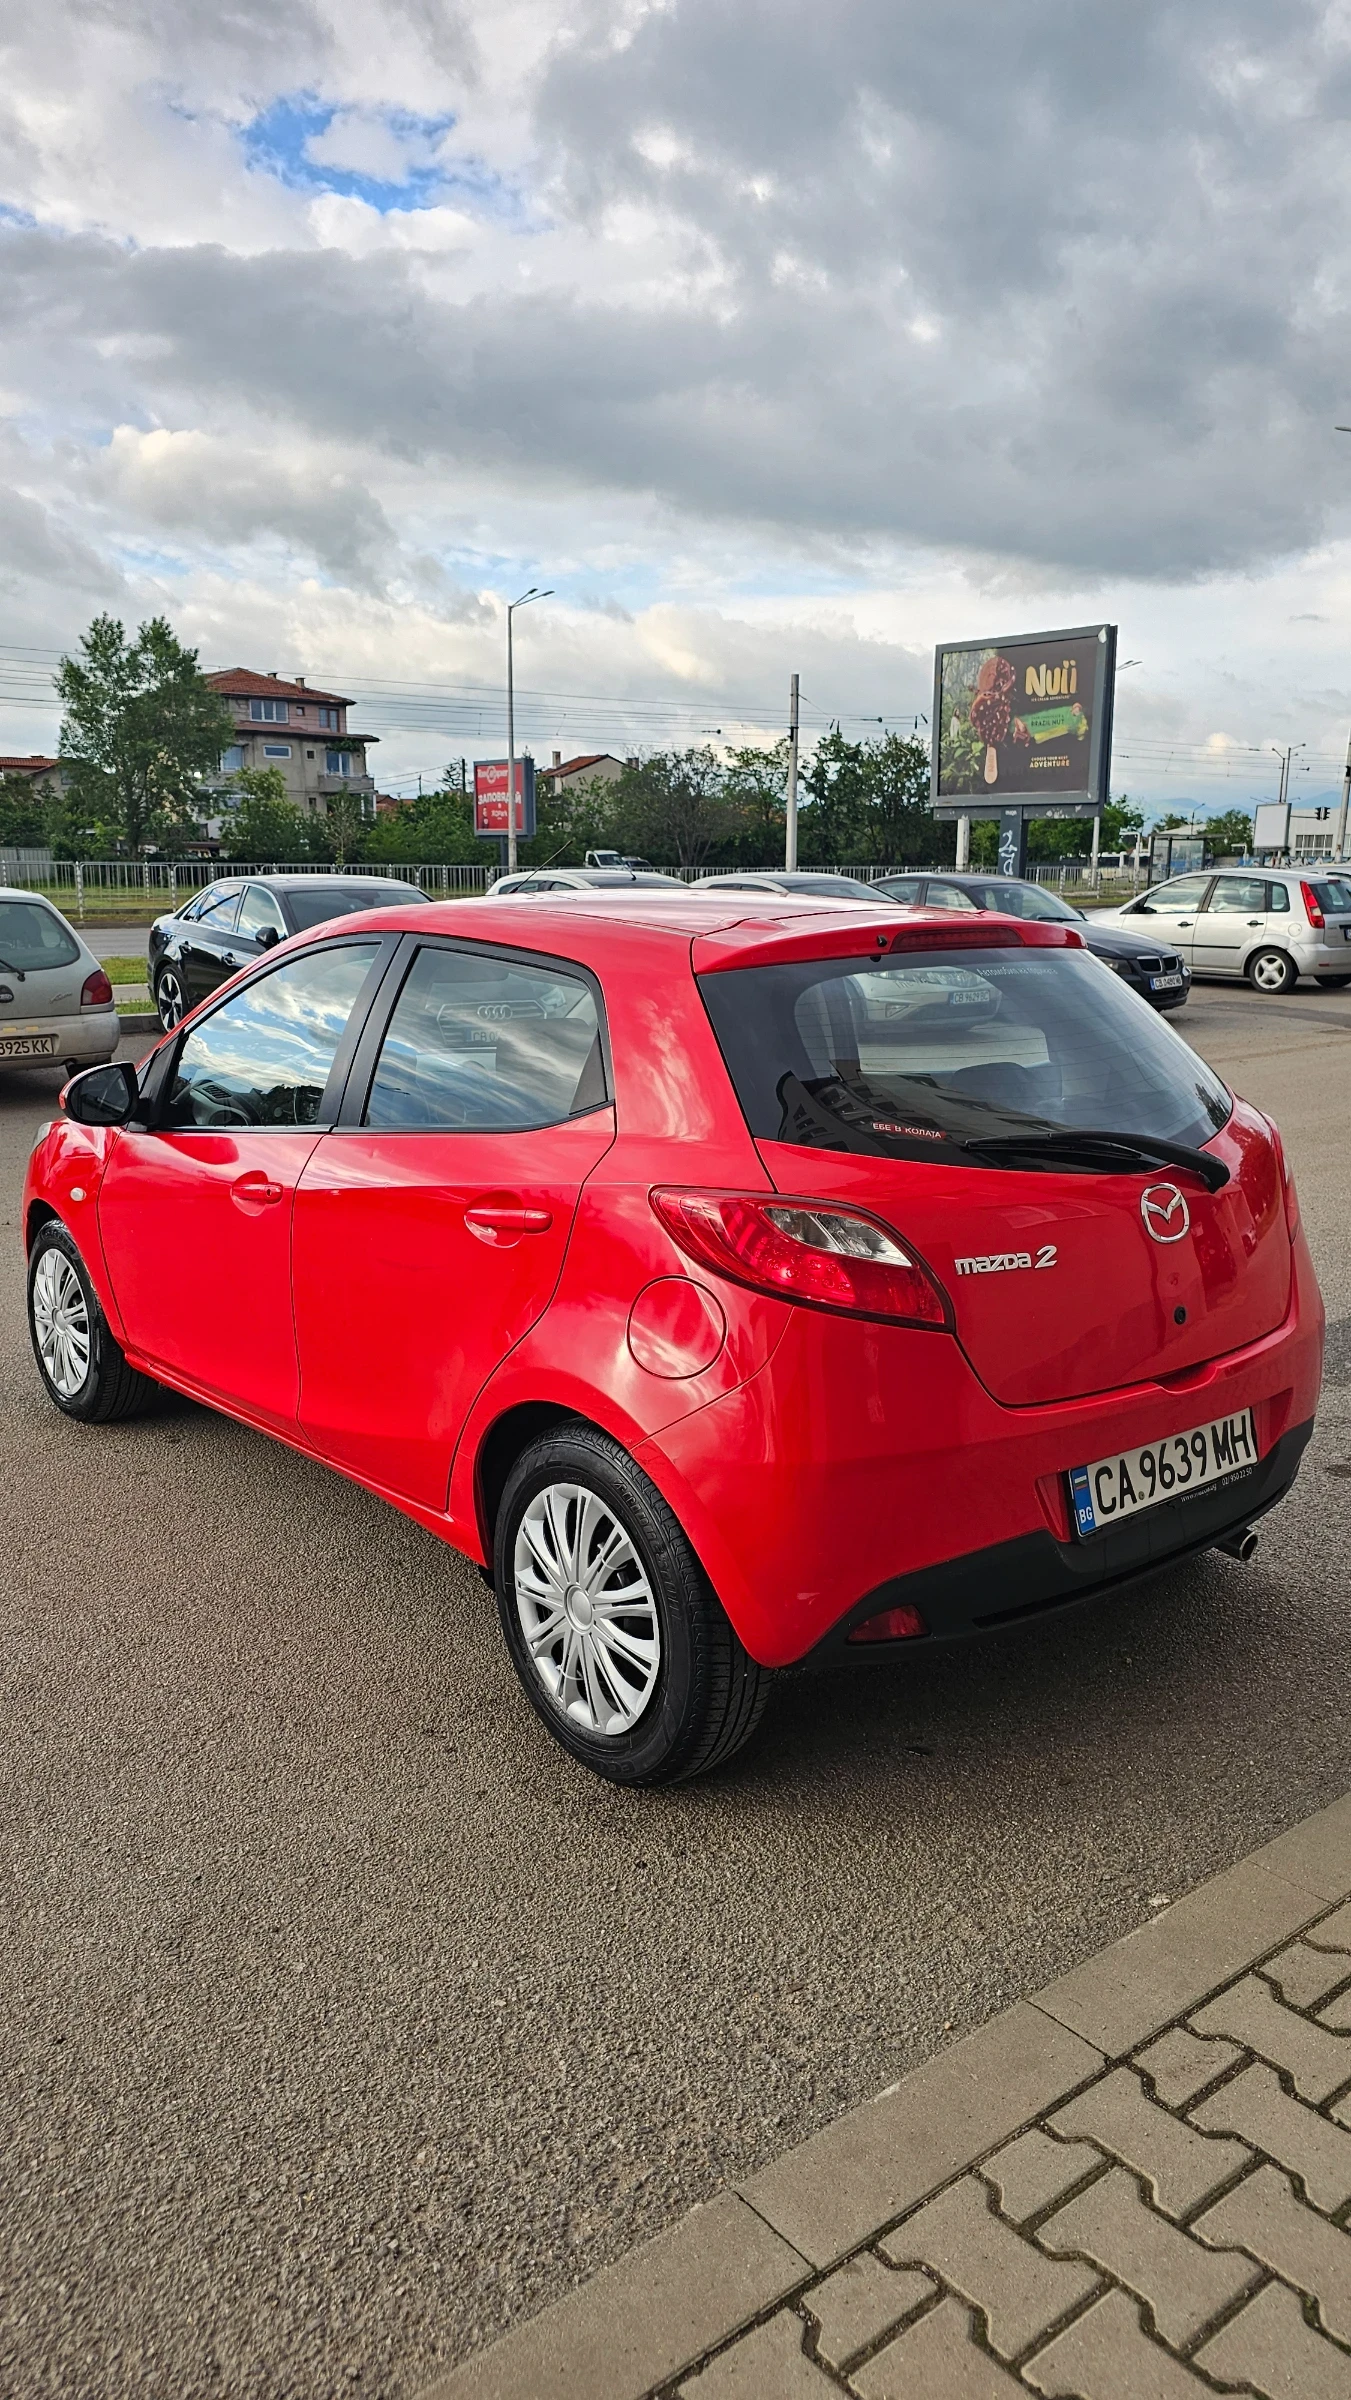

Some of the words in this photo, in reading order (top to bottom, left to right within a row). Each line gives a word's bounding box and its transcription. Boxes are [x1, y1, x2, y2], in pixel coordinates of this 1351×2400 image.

[1030, 760, 1069, 768] ADVENTURE
[954, 993, 963, 1003] CB
[32, 1040, 50, 1053] KK
[905, 1127, 942, 1138] КОЛАТА
[1094, 1458, 1137, 1515] CA
[1139, 1431, 1207, 1499] 9639
[1211, 1414, 1252, 1470] MH
[1079, 1506, 1093, 1524] BG
